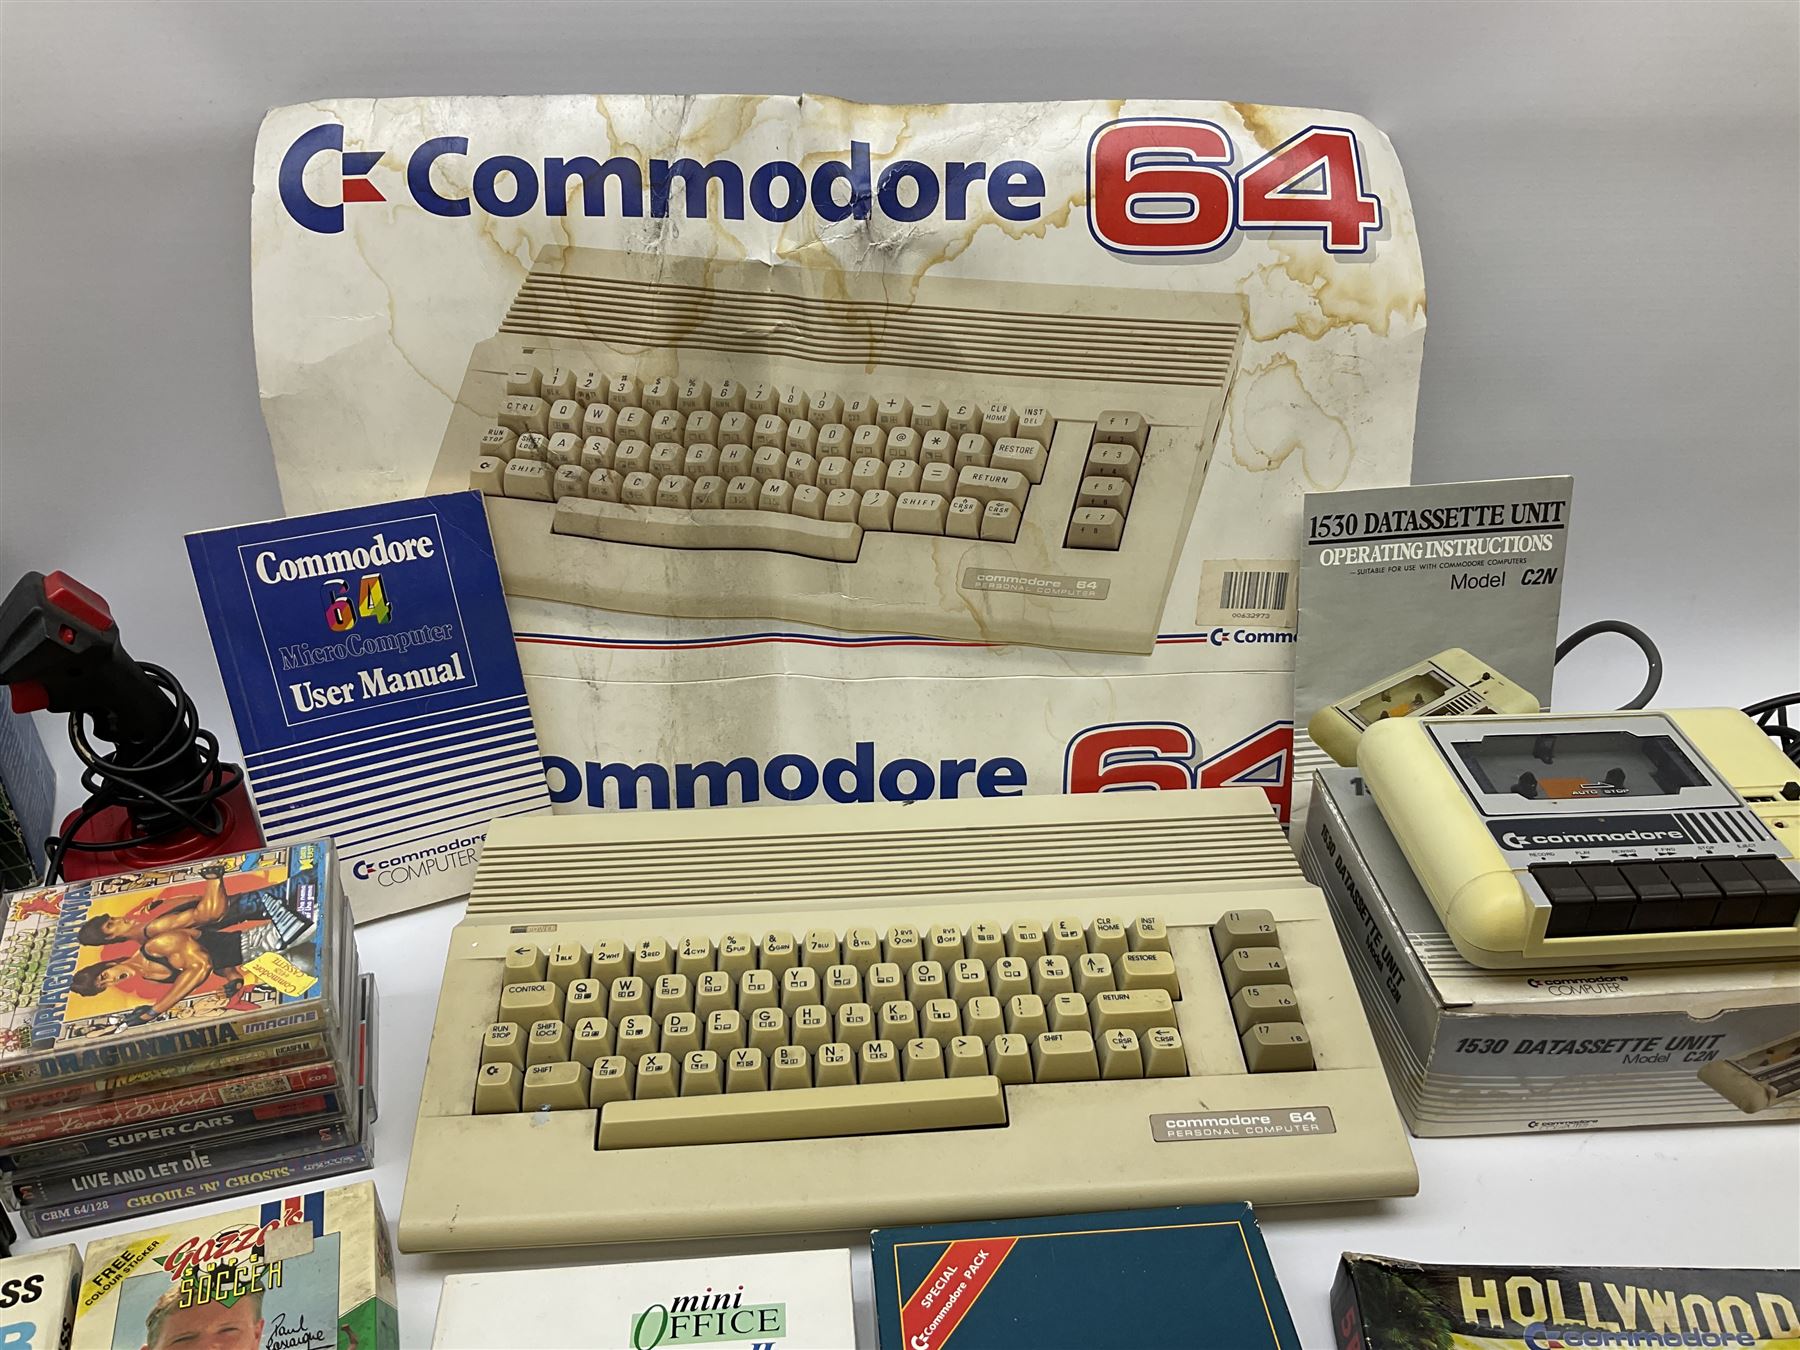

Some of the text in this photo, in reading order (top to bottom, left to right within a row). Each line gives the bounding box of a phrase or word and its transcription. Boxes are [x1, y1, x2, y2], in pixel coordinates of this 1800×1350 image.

[407, 116, 1383, 255] Commodore 64
[1310, 501, 1566, 538] 1530 DATASSETTE UNIT
[256, 534, 435, 585] Commodore
[1319, 534, 1554, 567] OPERATING INSTRUCTIONS
[1357, 557, 1527, 576] SUITABLE FOR USE WITH COMMODORE COMPUTERS
[1450, 567, 1558, 590] Model C2N
[975, 582, 1096, 597] PERSONAL COMPUTER
[977, 573, 1098, 590] commodore 64
[320, 572, 393, 633] 64
[279, 623, 453, 671] MicroComputer
[289, 652, 466, 714] User Manual
[541, 720, 1294, 830] ommodore 64
[1532, 829, 1684, 845] commodore
[378, 833, 488, 870] commodore
[377, 847, 479, 887] COMPUTER
[1320, 824, 1406, 987] 1530 DATASSETTE UNIT
[1127, 954, 1158, 962] RESTORE
[1366, 934, 1402, 1004] Model C2N
[508, 984, 547, 994] CONTROL
[1544, 975, 1629, 986] commodore
[1548, 982, 1624, 996] COMPUTER
[1102, 993, 1130, 1001] RETURN
[492, 1032, 511, 1040] STOP
[537, 1022, 556, 1030] SHIFT
[1044, 1034, 1064, 1042] SHIFT
[1456, 1034, 1726, 1055] 1530 DATASSETTE UNIT
[1622, 1050, 1719, 1065] Model C2N
[532, 1066, 552, 1074] SHIFT
[108, 1114, 234, 1148] SUPER CARS
[1165, 1112, 1318, 1129] commodore 64
[1167, 1123, 1320, 1138] PERSONAL COMPUTER
[72, 1145, 212, 1192] LIVE AND LET DIE
[126, 1186, 197, 1209] GHOULS
[226, 1166, 290, 1188] GHOSTS
[41, 1200, 110, 1222] CBM 64/128
[84, 1240, 160, 1307] COLOUR STICKER
[92, 1250, 136, 1287] FREE
[184, 1254, 258, 1278] SUPE
[670, 1285, 744, 1313] mini
[920, 1264, 958, 1309] SPECIAL
[924, 1248, 990, 1336] Commodore PACK
[1458, 1276, 1800, 1340] HOLLYWOOD
[633, 1304, 781, 1350] OFFICE
[1562, 1328, 1756, 1348] commodore
